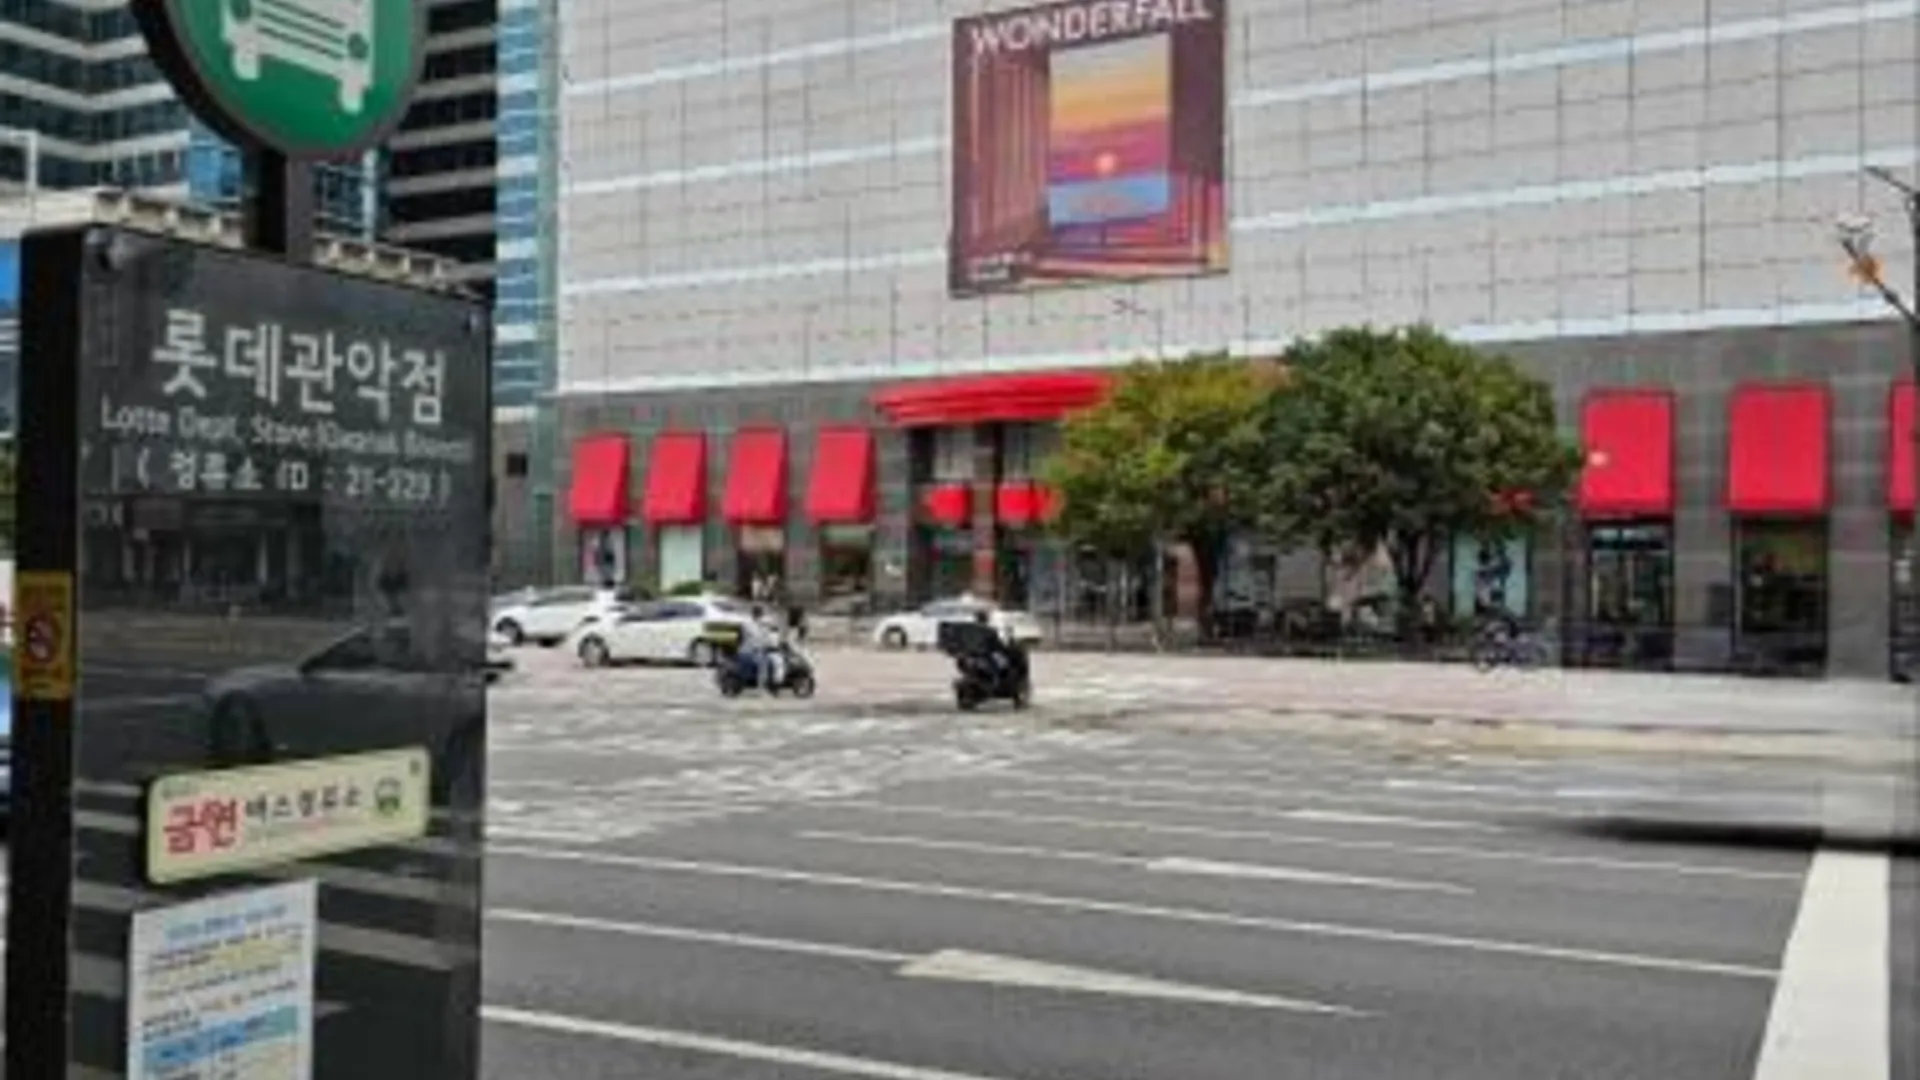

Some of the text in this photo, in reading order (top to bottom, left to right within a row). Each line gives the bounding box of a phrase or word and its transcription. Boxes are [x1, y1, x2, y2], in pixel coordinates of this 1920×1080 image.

[972, 0, 1211, 54] WONDERFALL
[152, 309, 445, 424] 롯데관악점
[164, 798, 237, 854] 금연
